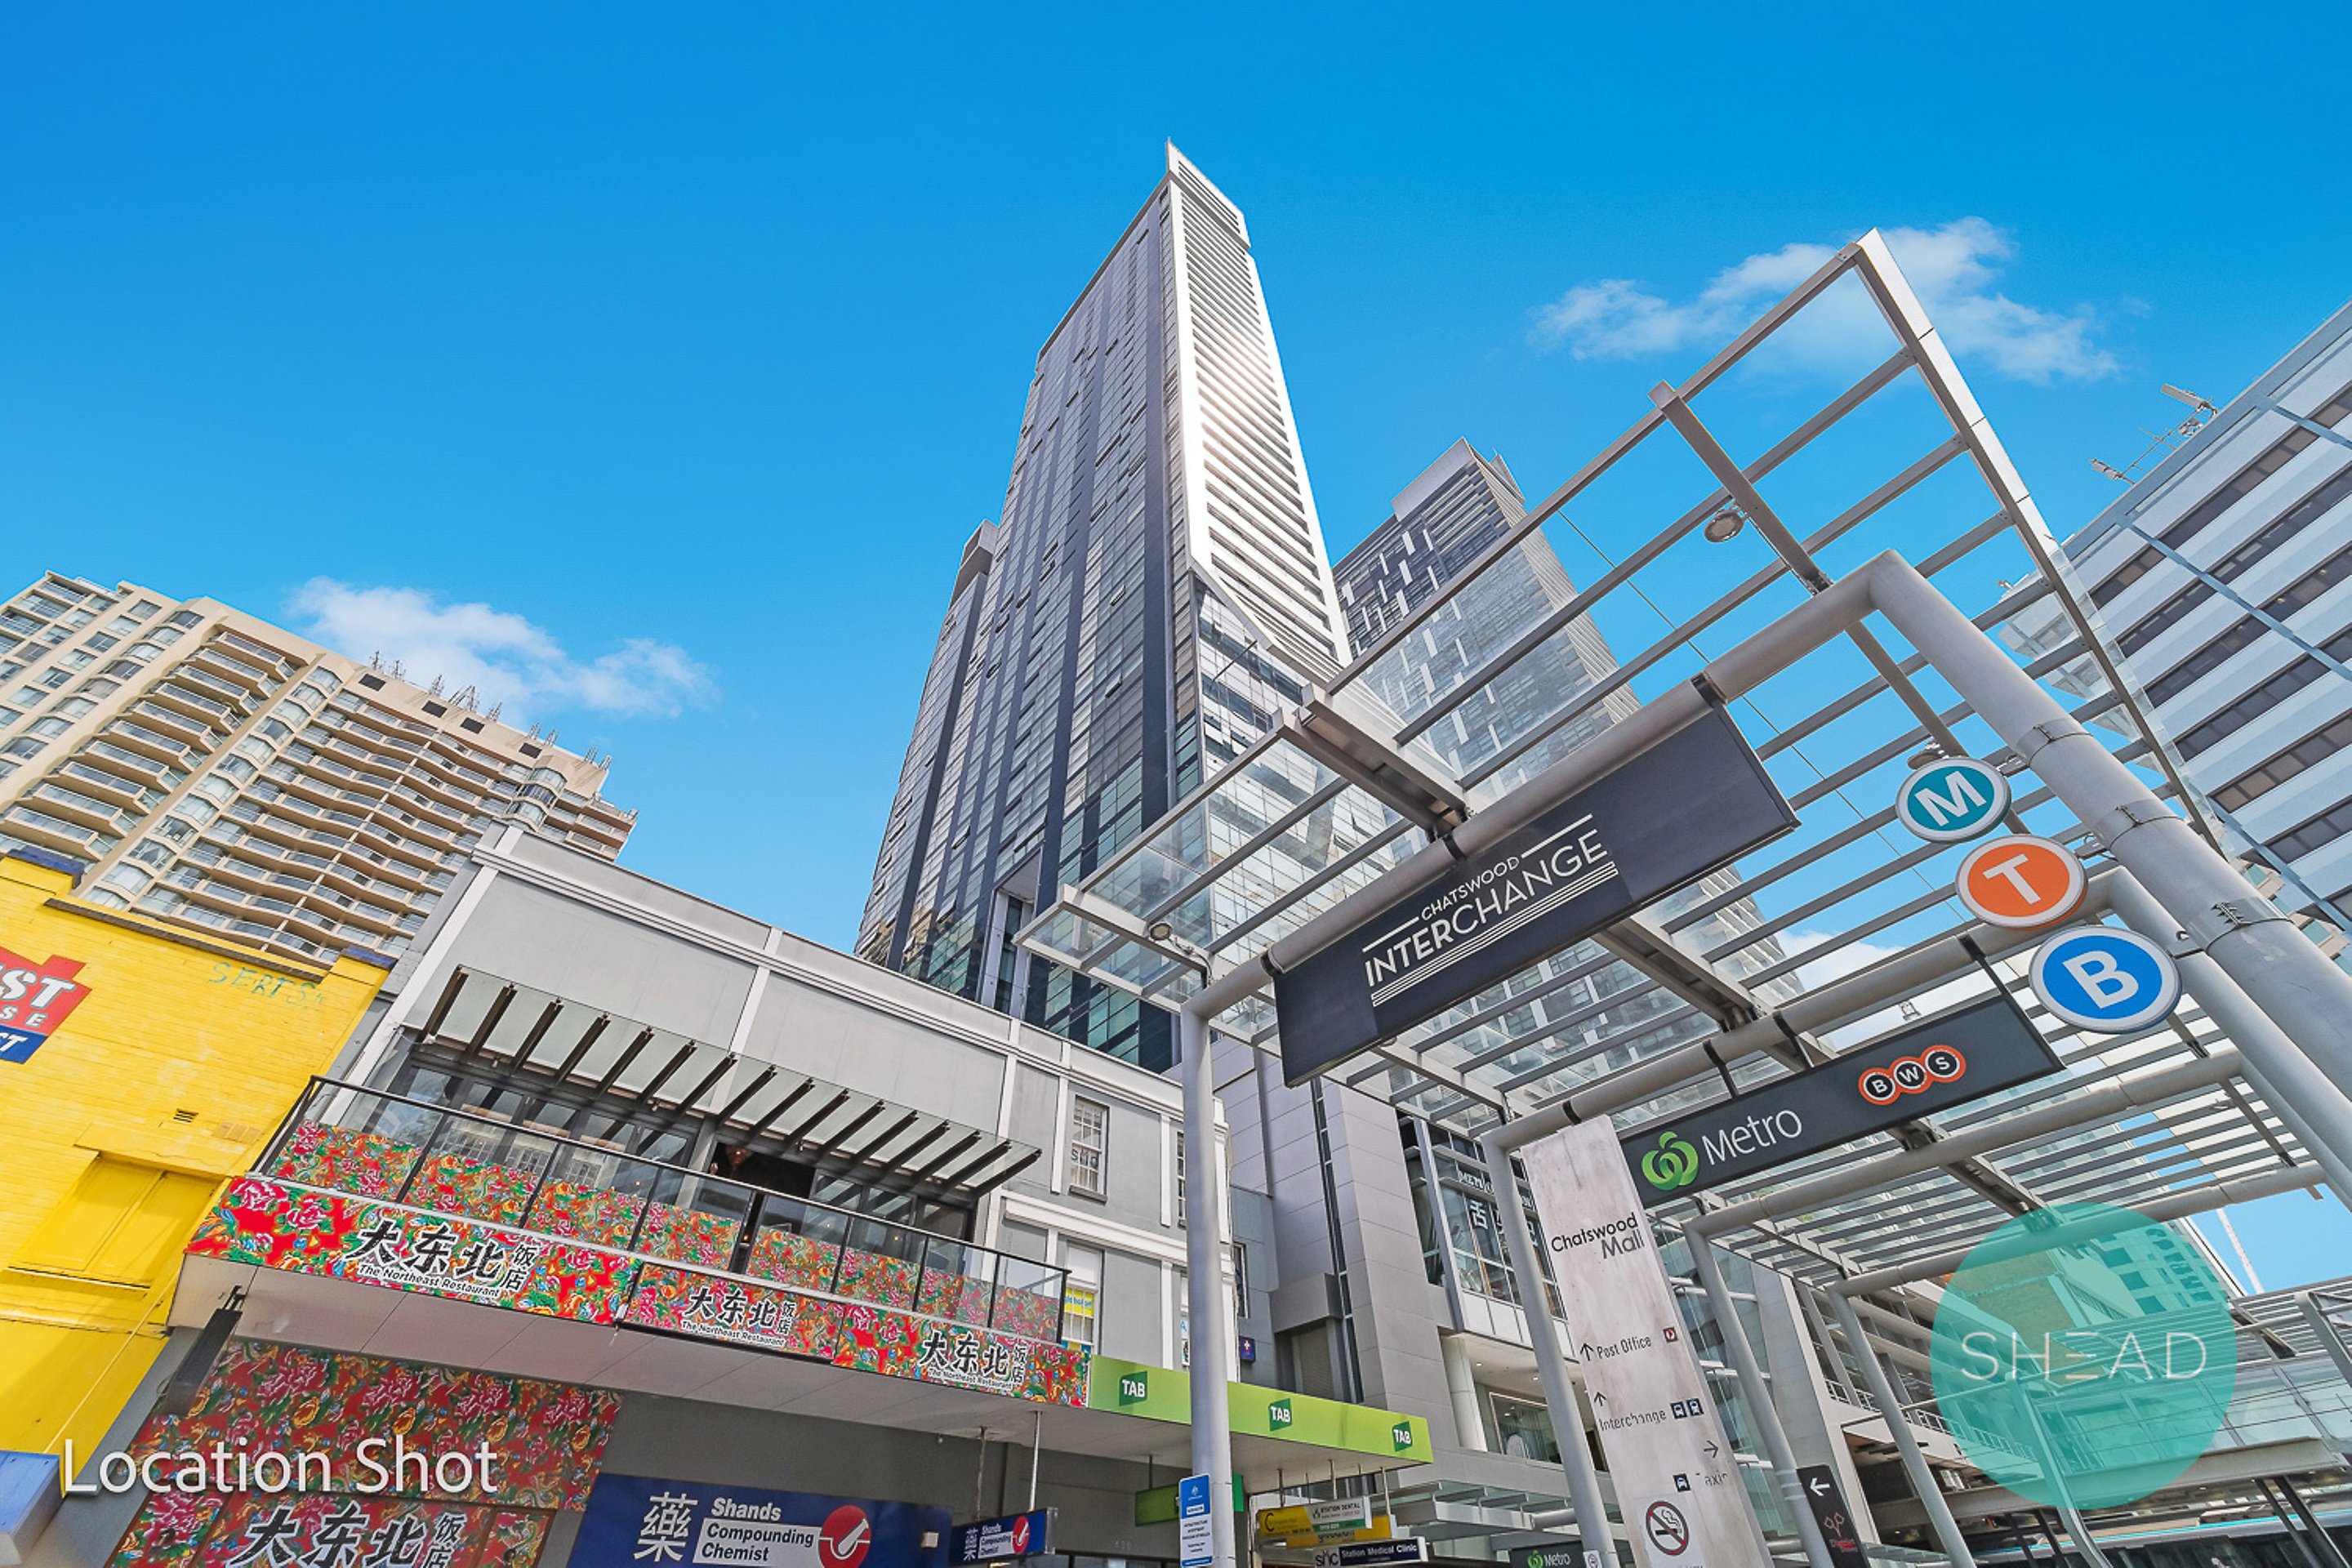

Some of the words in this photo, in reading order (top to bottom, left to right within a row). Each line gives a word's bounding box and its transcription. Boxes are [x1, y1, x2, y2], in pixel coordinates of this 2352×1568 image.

[1914, 771, 1986, 826] M
[1421, 856, 1520, 921] CHATSWOOD
[1983, 853, 2042, 905] T
[1364, 828, 1608, 987] INTERCHANGE
[2062, 951, 2140, 1009] B
[1869, 1052, 1953, 1097] BWS
[1701, 1108, 1803, 1165] Metro
[345, 1219, 504, 1280] 大东北
[1551, 1211, 1639, 1252] Chatswood
[1601, 1228, 1646, 1259] Mall
[360, 1264, 381, 1276] The
[383, 1267, 439, 1285] Northeast
[441, 1279, 501, 1297] Restaurant
[500, 1243, 538, 1292] 饭店
[682, 1321, 697, 1330] The
[684, 1288, 776, 1327] 大东北
[919, 1332, 1009, 1375] 大东北
[1597, 1344, 1620, 1360] Post
[1620, 1336, 1652, 1353] Office
[1121, 1379, 1145, 1397] TAB
[1270, 1405, 1290, 1423] TAB
[1393, 1428, 1411, 1445] TAB
[1695, 1470, 1728, 1486] axi
[633, 1491, 698, 1562] 藥
[710, 1497, 782, 1521] Shands
[229, 1503, 425, 1567] 大东北
[702, 1542, 769, 1561] Chemist
[706, 1522, 814, 1548] Compounding
[1396, 1544, 1418, 1553] Clinic
[1544, 1552, 1571, 1567] Metro
